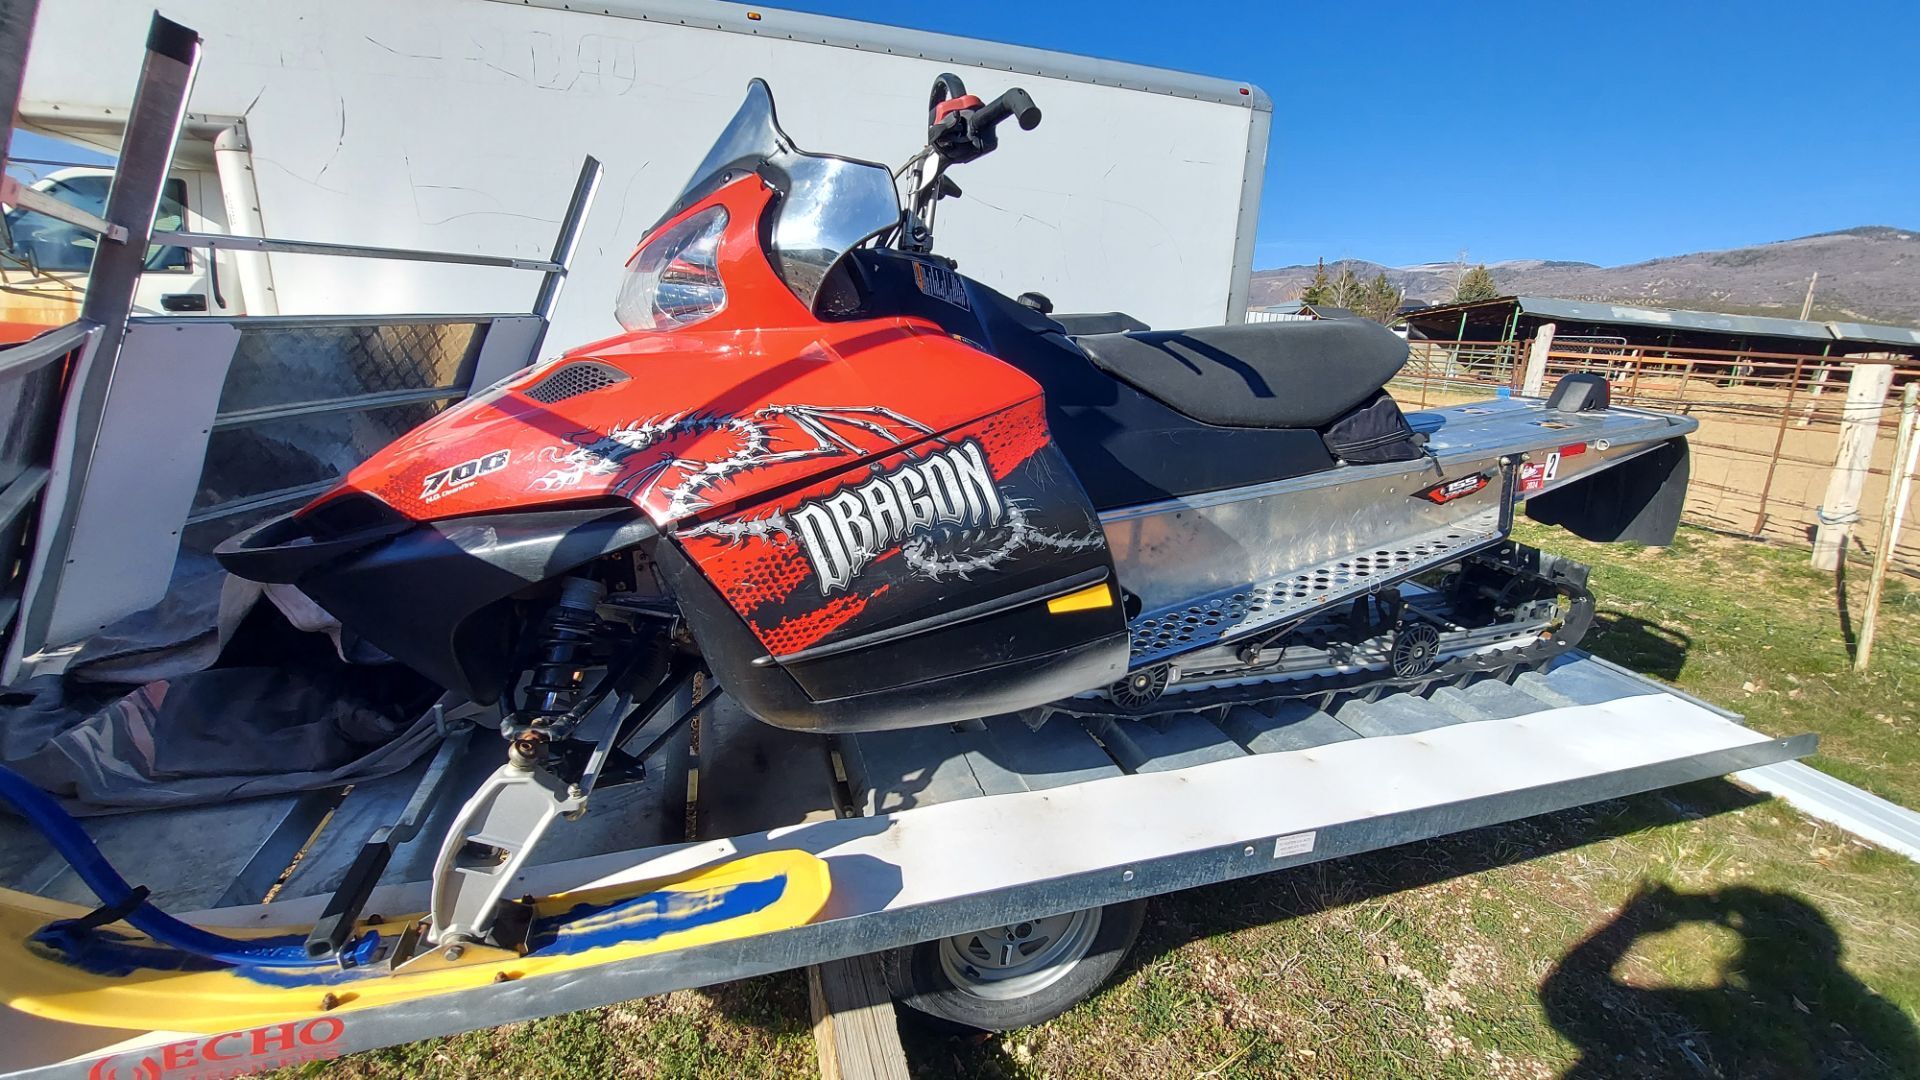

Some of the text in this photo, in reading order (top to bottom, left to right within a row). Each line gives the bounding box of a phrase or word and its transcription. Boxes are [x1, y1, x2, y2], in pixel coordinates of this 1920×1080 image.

[420, 449, 511, 498] 700
[1447, 475, 1478, 491] 155
[1546, 454, 1557, 478] 2
[790, 440, 1003, 596] DRAGON
[160, 1016, 346, 1070] ECHO
